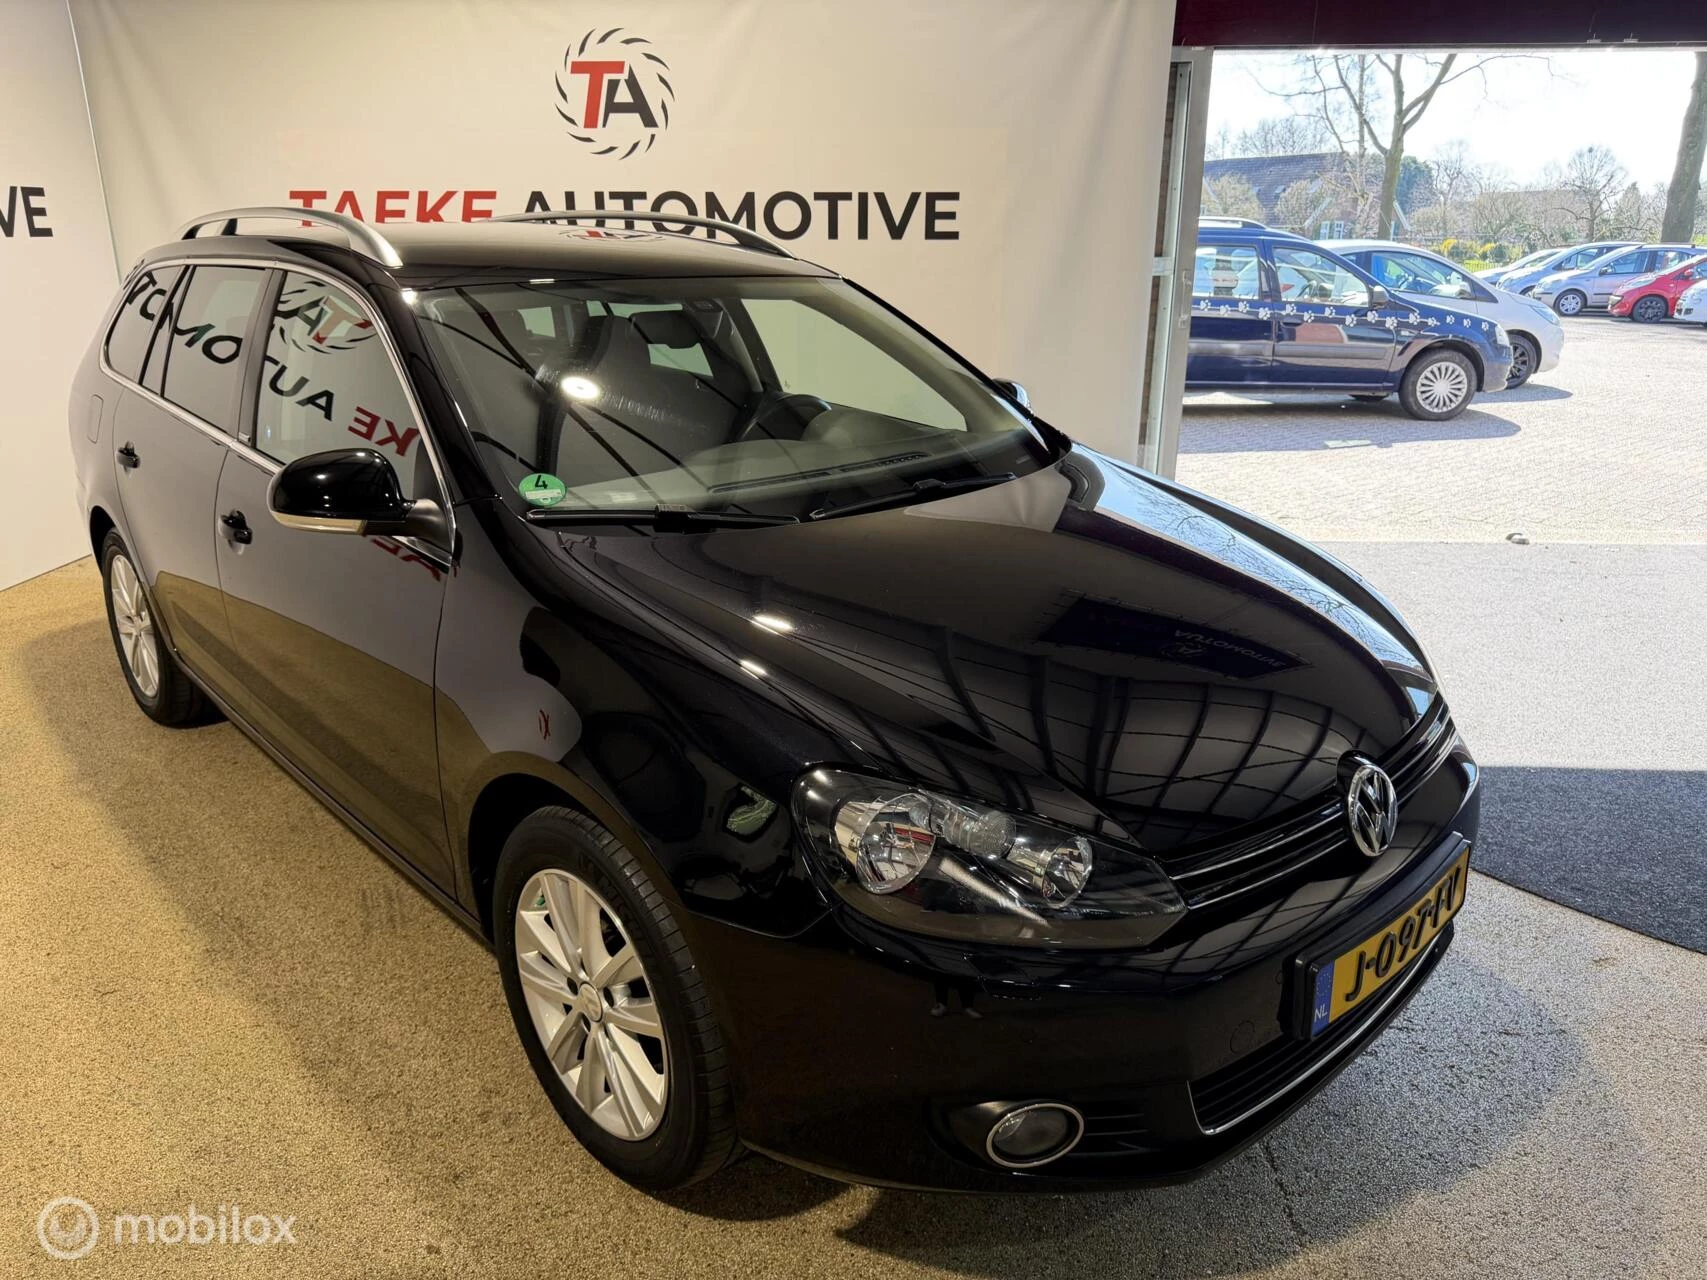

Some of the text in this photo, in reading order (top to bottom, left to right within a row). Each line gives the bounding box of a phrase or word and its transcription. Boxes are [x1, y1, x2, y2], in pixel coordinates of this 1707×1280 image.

[569, 60, 660, 129] TA
[534, 474, 549, 490] 4
[1314, 1008, 1328, 1023] NL
